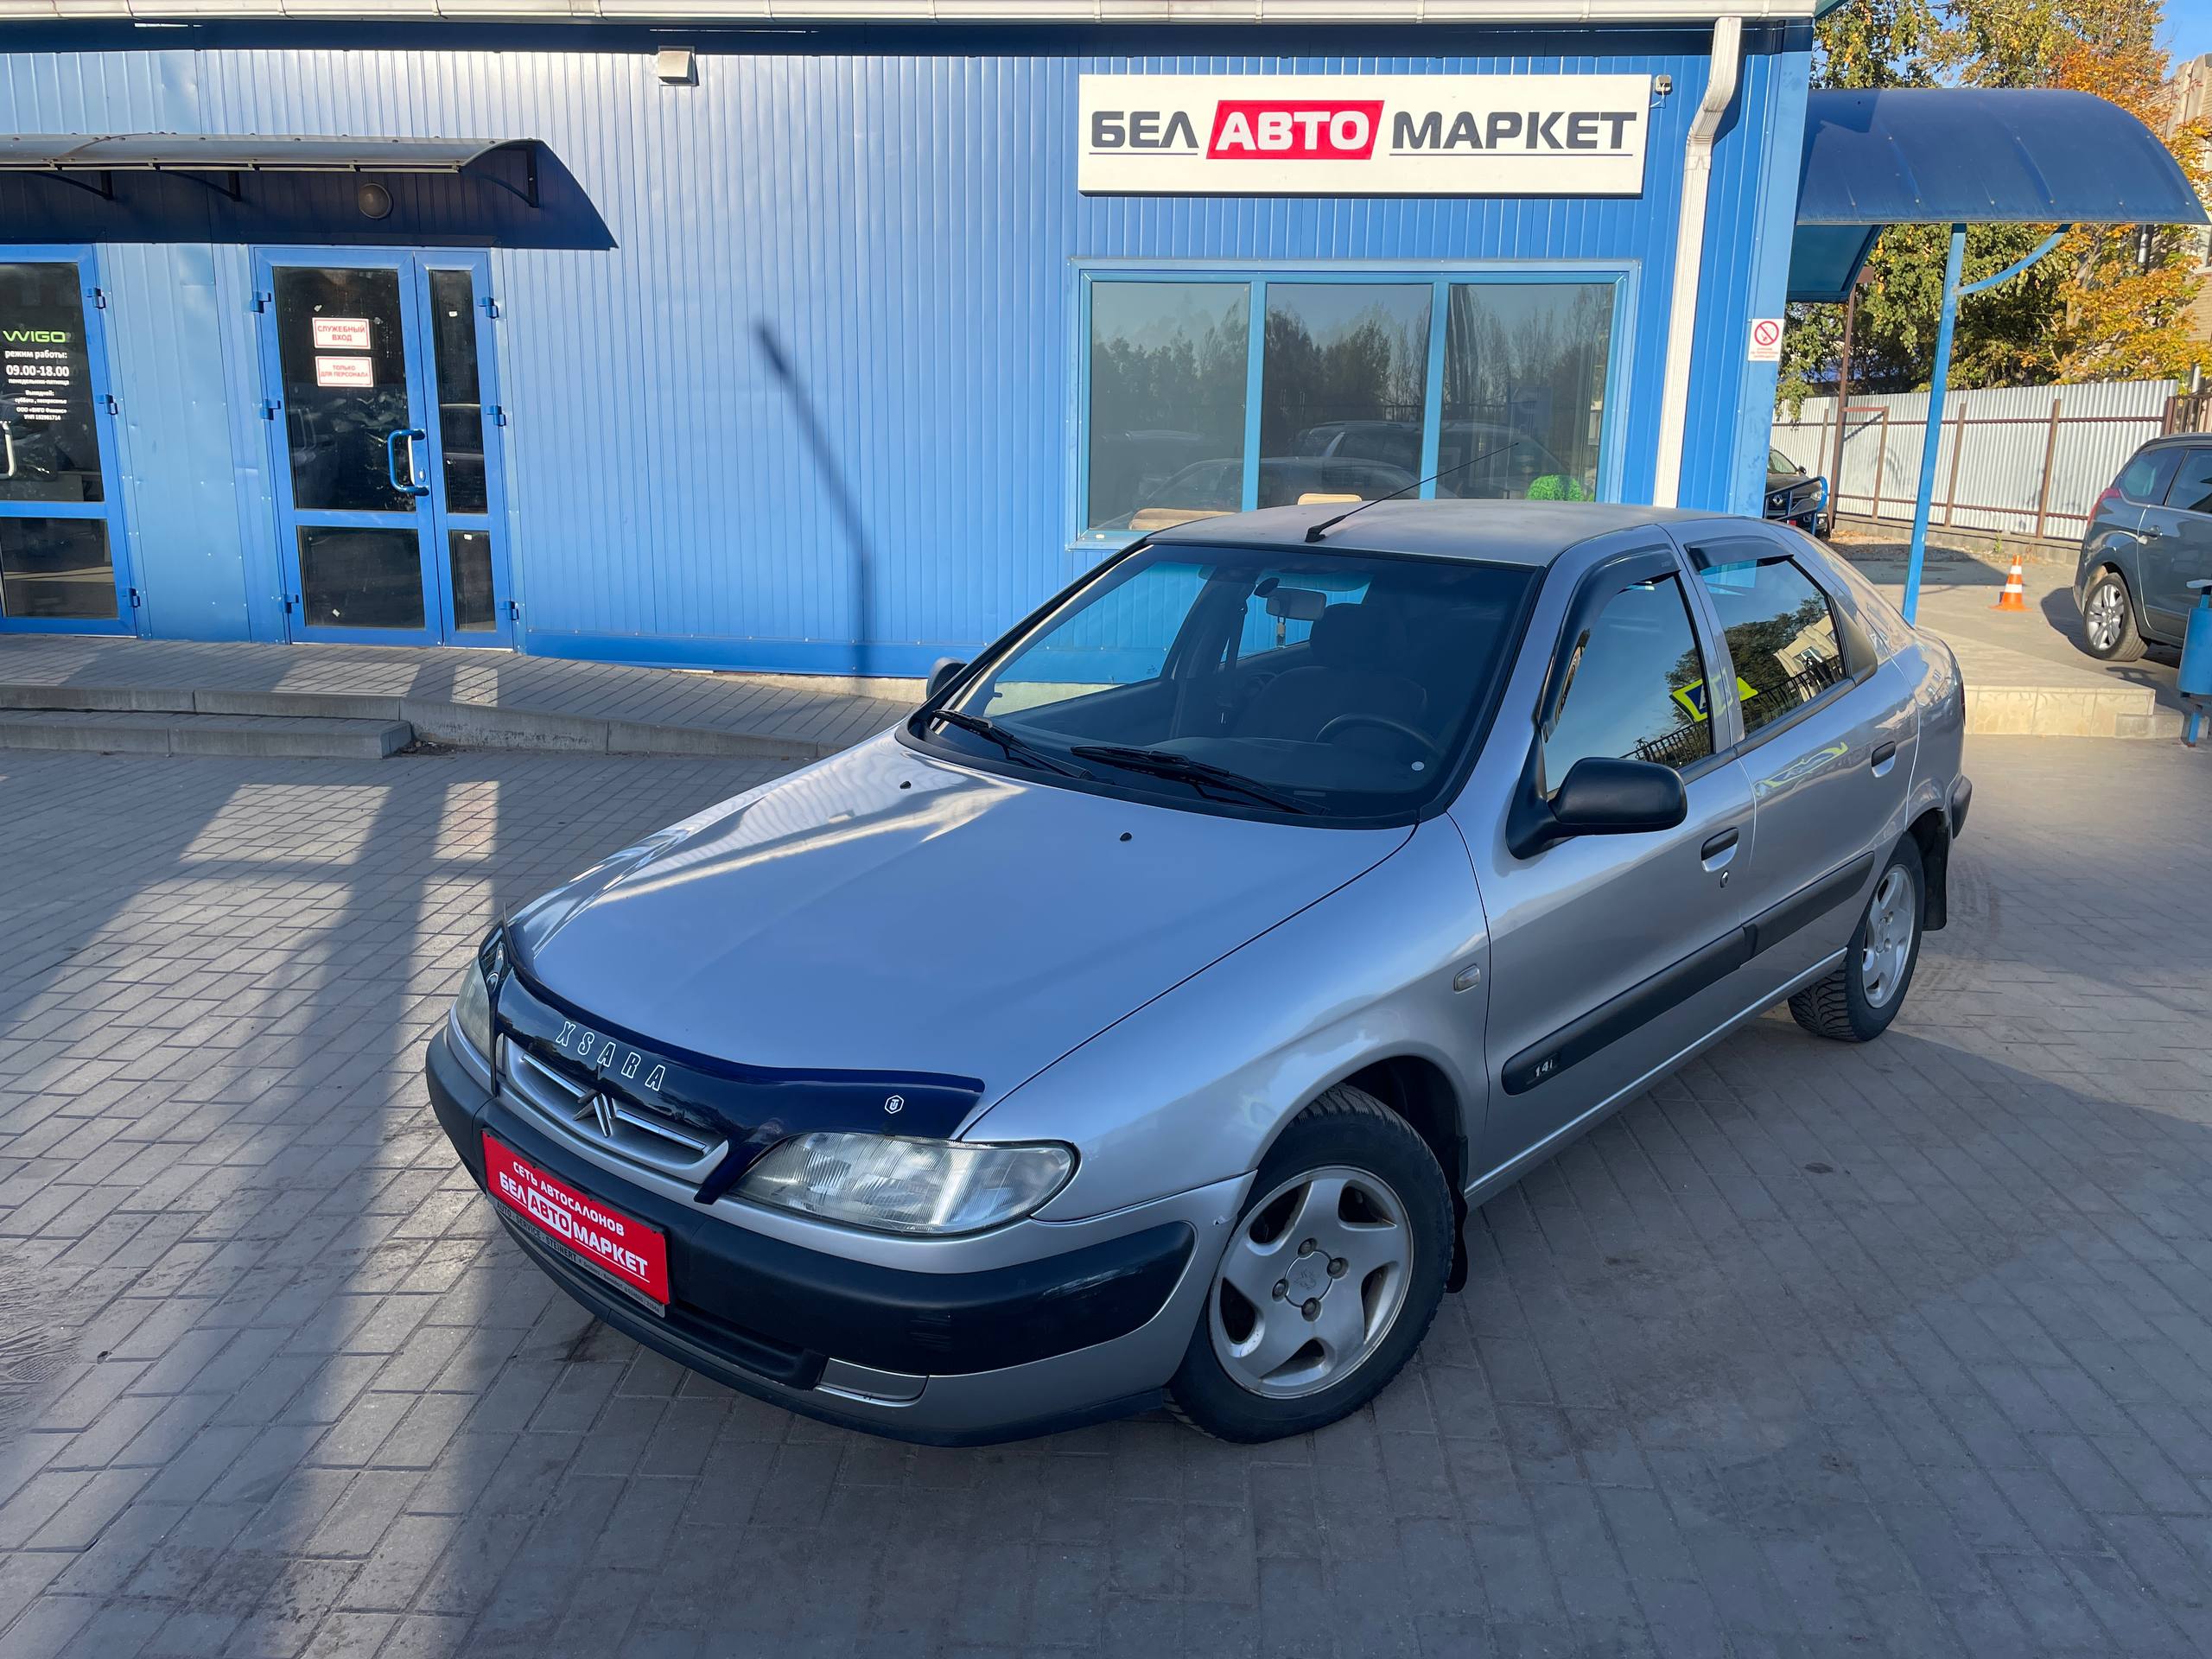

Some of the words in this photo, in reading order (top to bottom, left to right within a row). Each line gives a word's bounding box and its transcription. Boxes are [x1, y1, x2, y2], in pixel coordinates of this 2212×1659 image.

[1091, 111, 1199, 149] БЕЛ
[1214, 111, 1370, 151] АВТО
[1391, 111, 1638, 149] МАРКЕТ
[3, 330, 66, 343] WIGO
[4, 350, 34, 359] режим
[35, 349, 67, 359] работы:
[6, 365, 69, 377] 09.00-18.00
[555, 1020, 666, 1092] XSARA
[512, 1160, 538, 1187] СЕТЬ
[540, 1179, 625, 1236] АВТОСАЛОНОВ
[499, 1171, 527, 1206] БЕЛ
[531, 1195, 569, 1232] АВТО
[573, 1222, 648, 1277] МАРКЕТ
